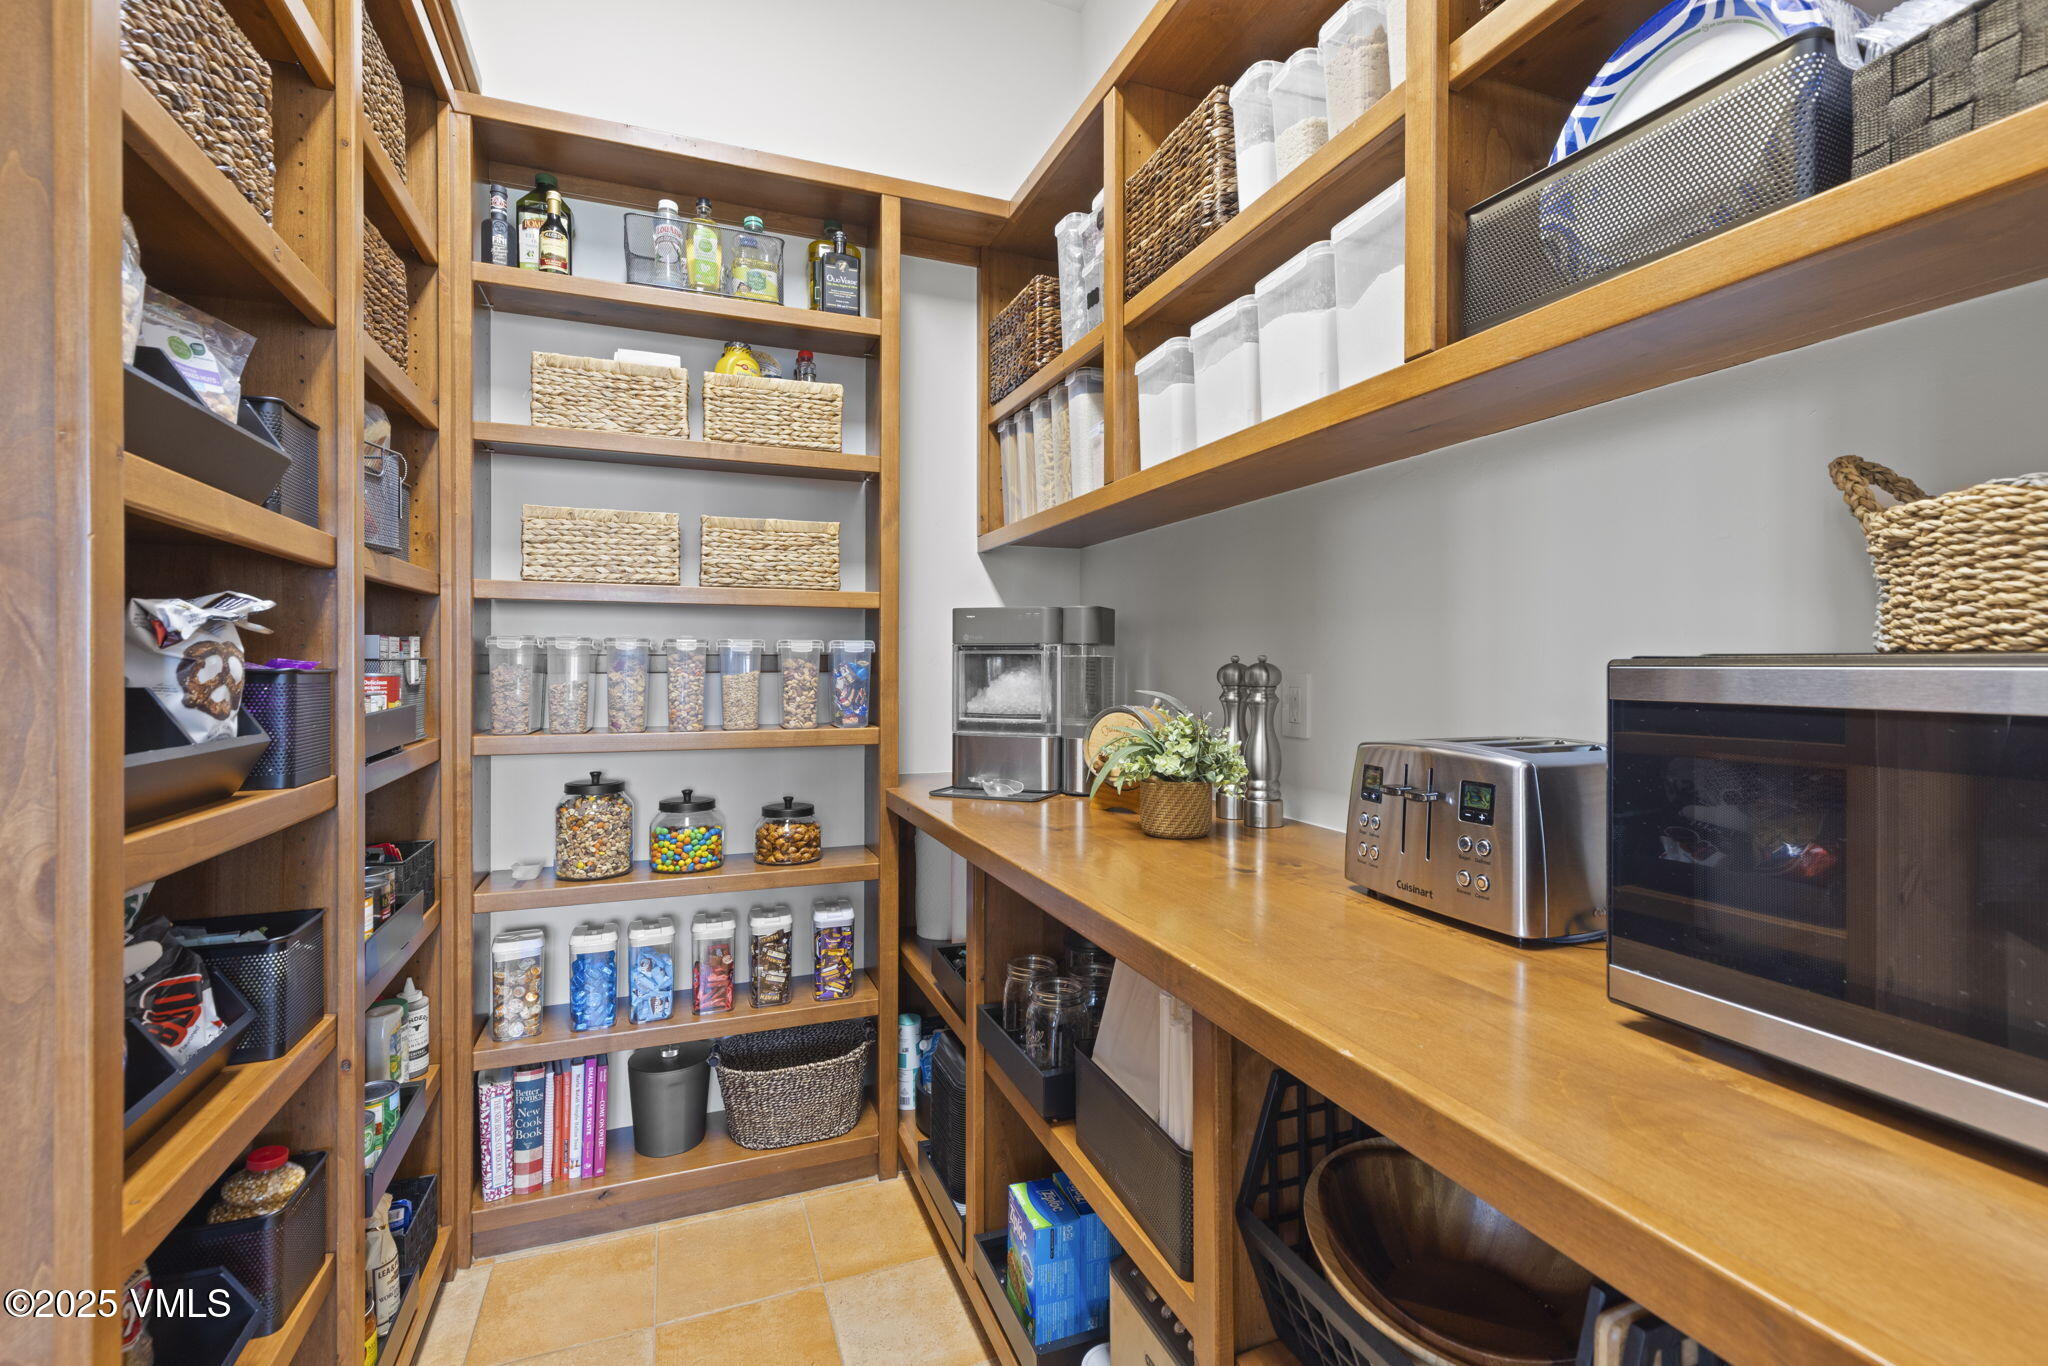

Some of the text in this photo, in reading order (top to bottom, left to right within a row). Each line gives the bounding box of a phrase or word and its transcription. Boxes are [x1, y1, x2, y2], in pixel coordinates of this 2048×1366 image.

[1396, 879, 1434, 899] Cuisinart
[515, 1088, 541, 1098] Better
[515, 1093, 544, 1104] Homes
[517, 1107, 540, 1118] New
[515, 1116, 542, 1129] Cook
[515, 1127, 543, 1140] Book
[1040, 1190, 1064, 1212] Ziploc
[1009, 1203, 1026, 1248] Ziploc
